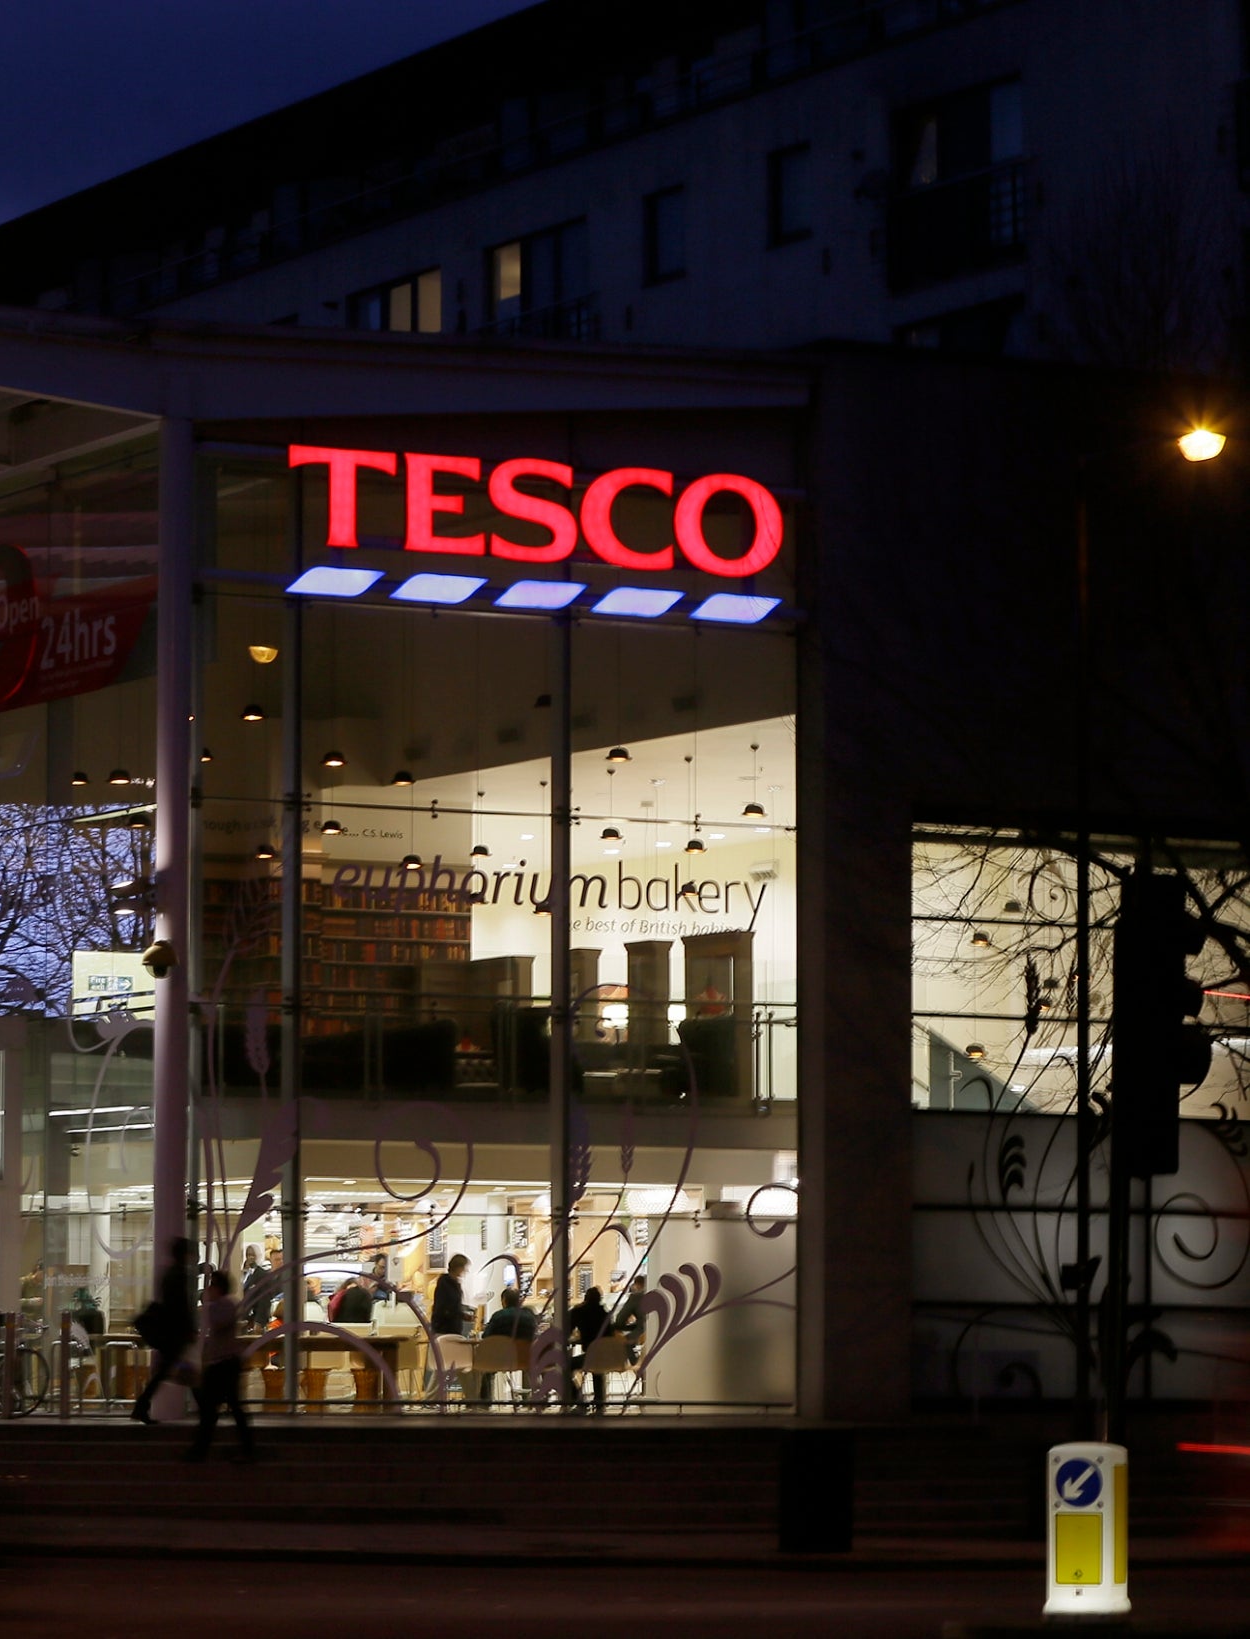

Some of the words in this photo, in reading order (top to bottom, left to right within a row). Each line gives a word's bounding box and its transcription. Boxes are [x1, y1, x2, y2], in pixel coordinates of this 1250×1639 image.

[288, 444, 784, 578] TESCO
[40, 608, 117, 671] 24hrs
[380, 829, 404, 839] Lewis
[585, 917, 616, 931] best
[620, 917, 637, 933] of
[639, 918, 687, 935] British
